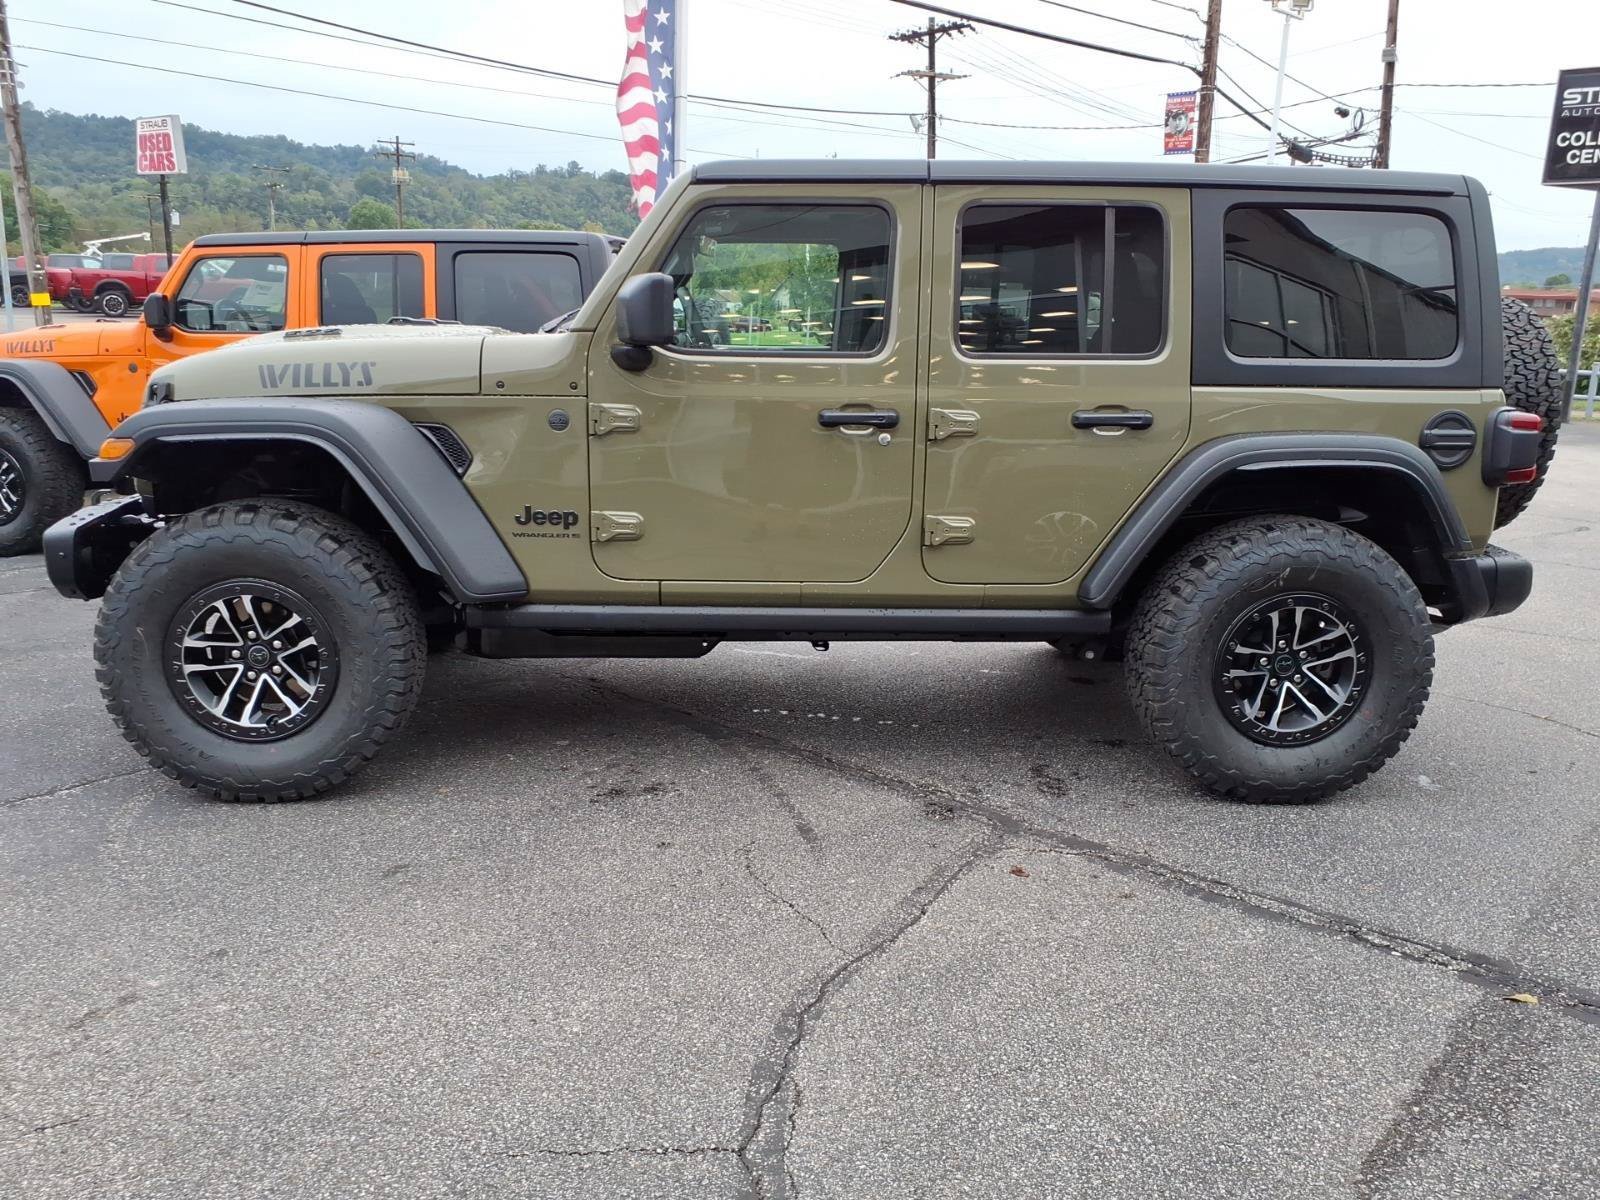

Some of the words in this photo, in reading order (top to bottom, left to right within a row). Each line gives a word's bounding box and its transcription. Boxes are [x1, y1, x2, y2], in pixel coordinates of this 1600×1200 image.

[1562, 86, 1600, 105] ST
[140, 119, 168, 129] STRAUB
[139, 132, 172, 152] USED
[1557, 130, 1600, 147] COL
[139, 152, 176, 171] CARS
[6, 339, 56, 354] WILLYS
[258, 361, 377, 388] WILLYS
[514, 504, 579, 530] Jeep
[512, 531, 570, 539] WRANGLER
